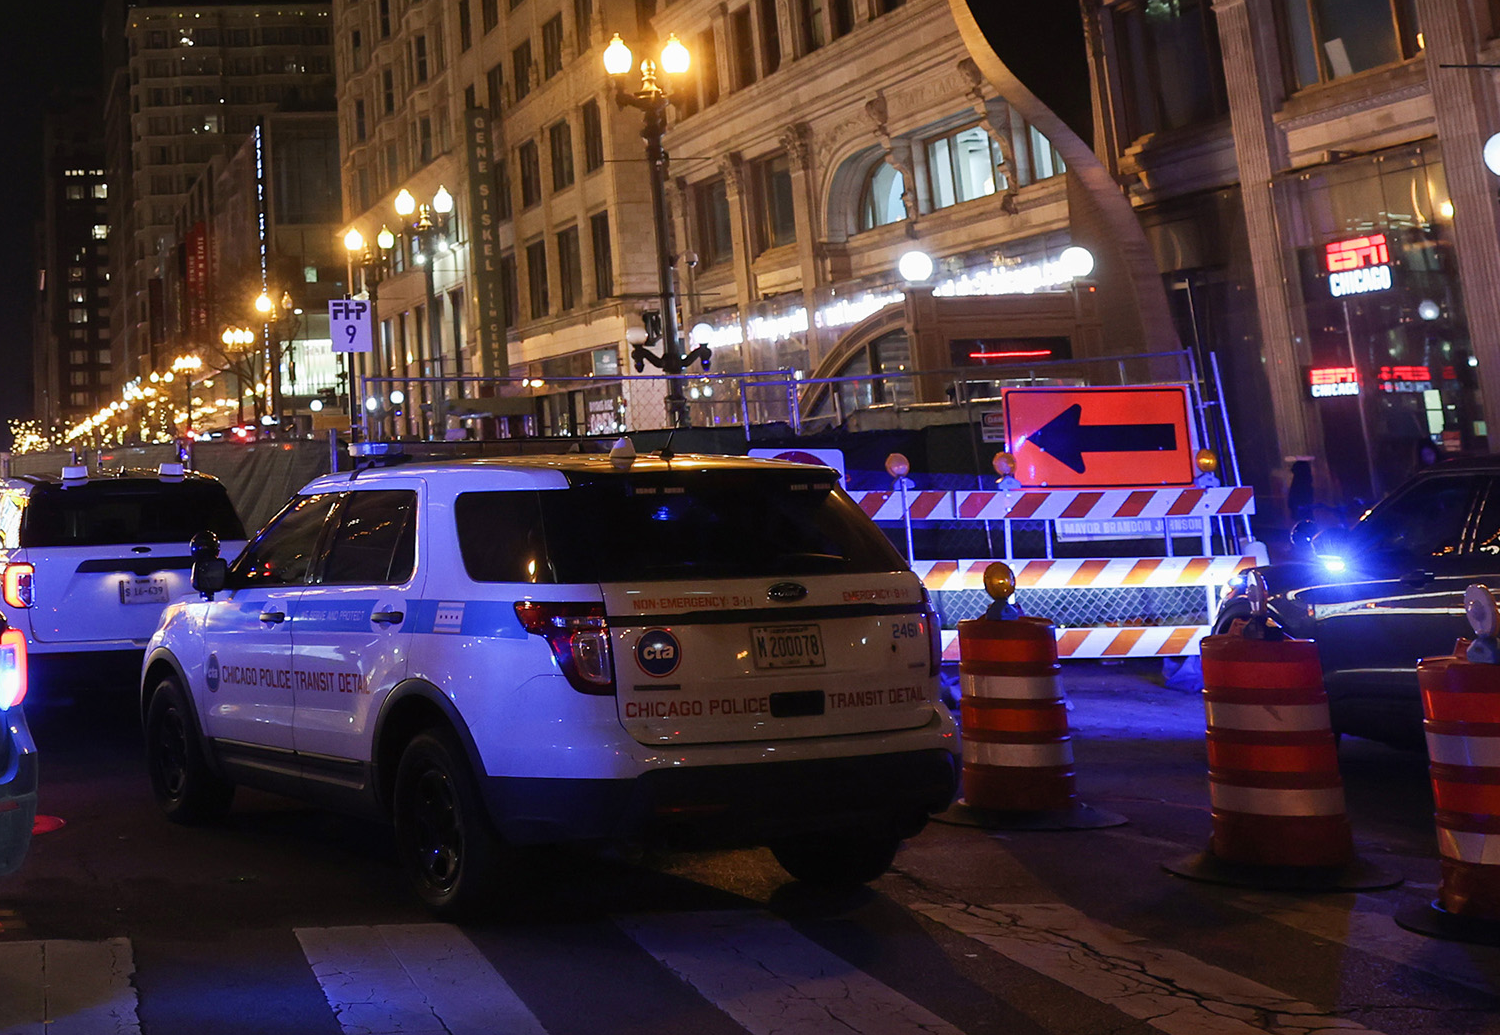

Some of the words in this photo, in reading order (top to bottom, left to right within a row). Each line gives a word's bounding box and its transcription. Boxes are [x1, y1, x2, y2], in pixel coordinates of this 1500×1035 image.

[474, 117, 487, 173] GENE
[479, 184, 493, 271] SISKEL
[1325, 233, 1390, 272] ESPN
[1329, 265, 1392, 297] CHICAGO
[345, 324, 356, 344] 9
[1064, 522, 1099, 535] MAYOR
[1103, 520, 1152, 534] BRANDON
[892, 622, 918, 639] 2461
[643, 643, 675, 661] cta
[770, 634, 819, 658] 200078
[222, 665, 258, 686] CHICAGO
[260, 668, 292, 689] POLICE
[294, 670, 334, 692] TRANSIT
[338, 673, 371, 695] DETAIL
[625, 701, 703, 718] CHICAGO
[709, 697, 768, 715] POLICE
[829, 689, 884, 709] TRANSIT
[889, 686, 926, 704] DETAIL
